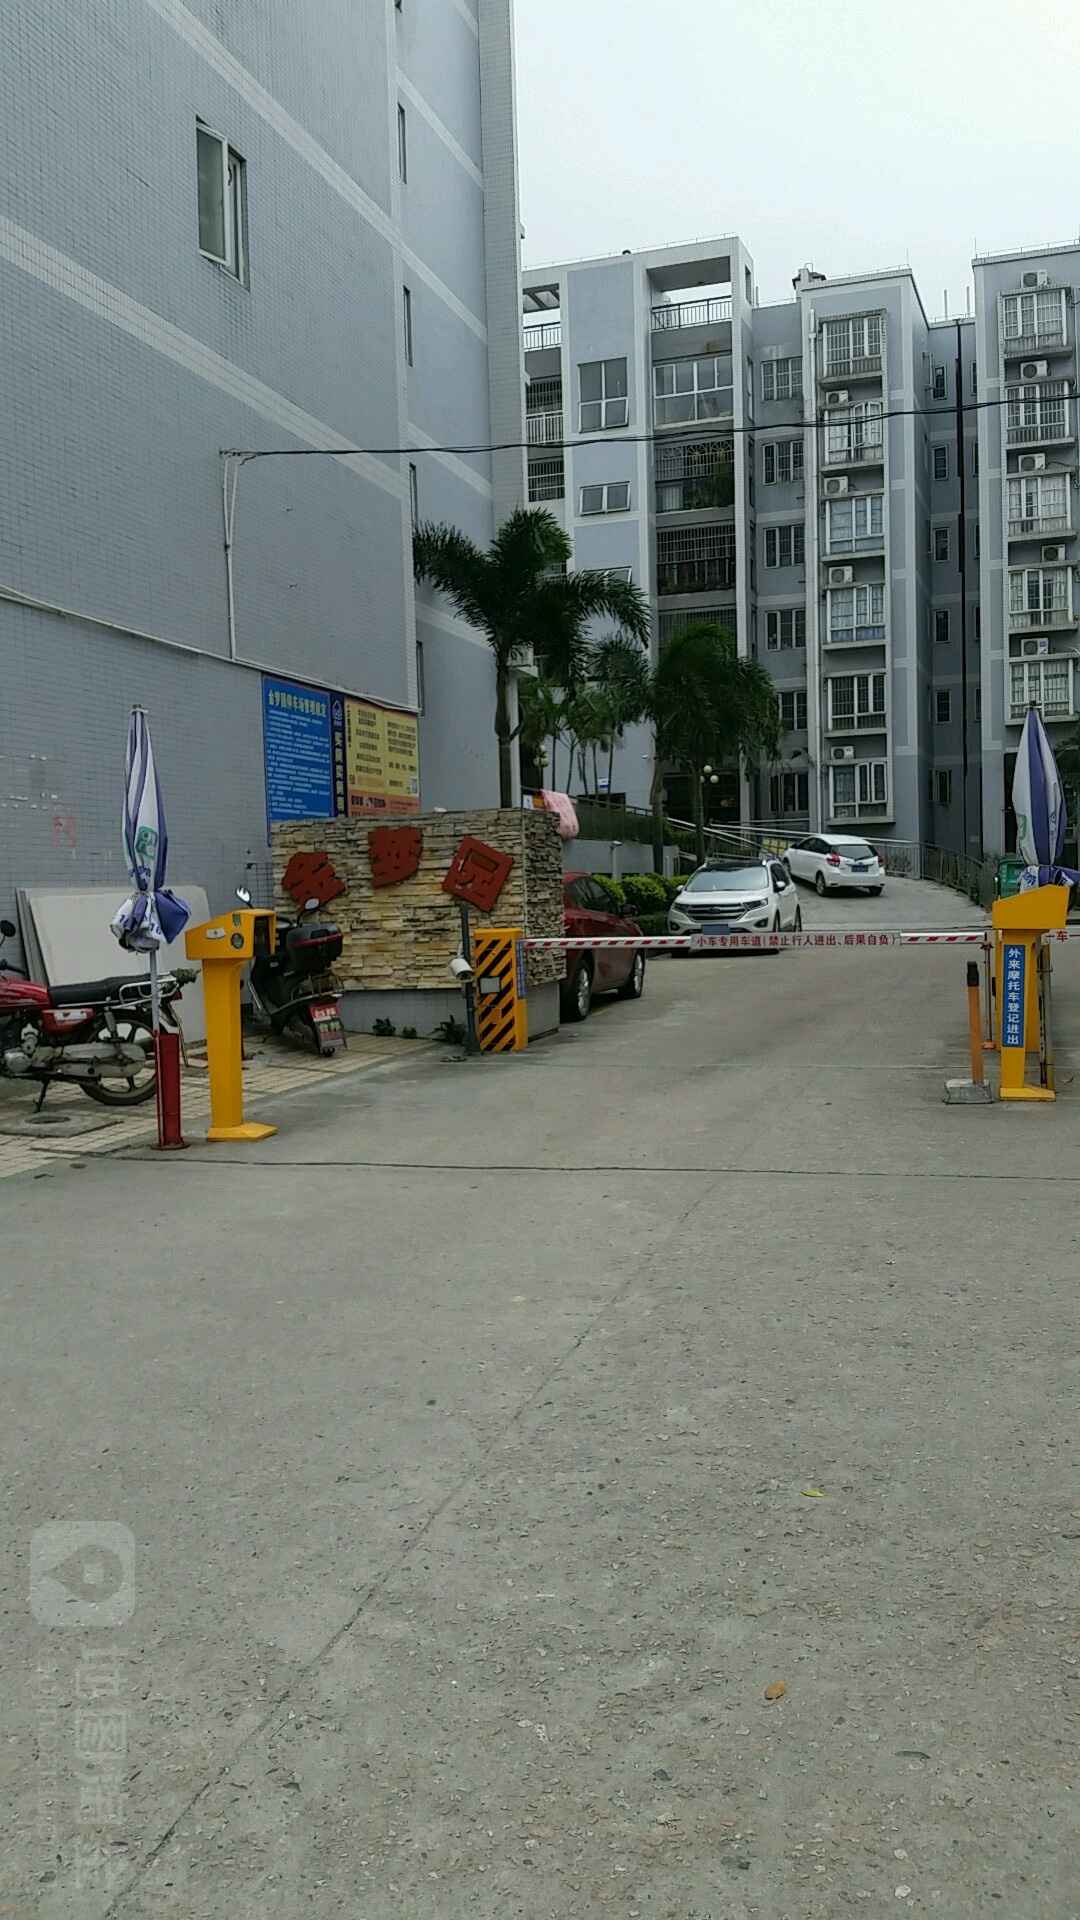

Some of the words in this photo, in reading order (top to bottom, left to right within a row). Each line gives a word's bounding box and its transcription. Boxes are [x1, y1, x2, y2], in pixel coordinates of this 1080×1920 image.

[1006, 947, 1021, 1046] 外来摩托车登记进出
